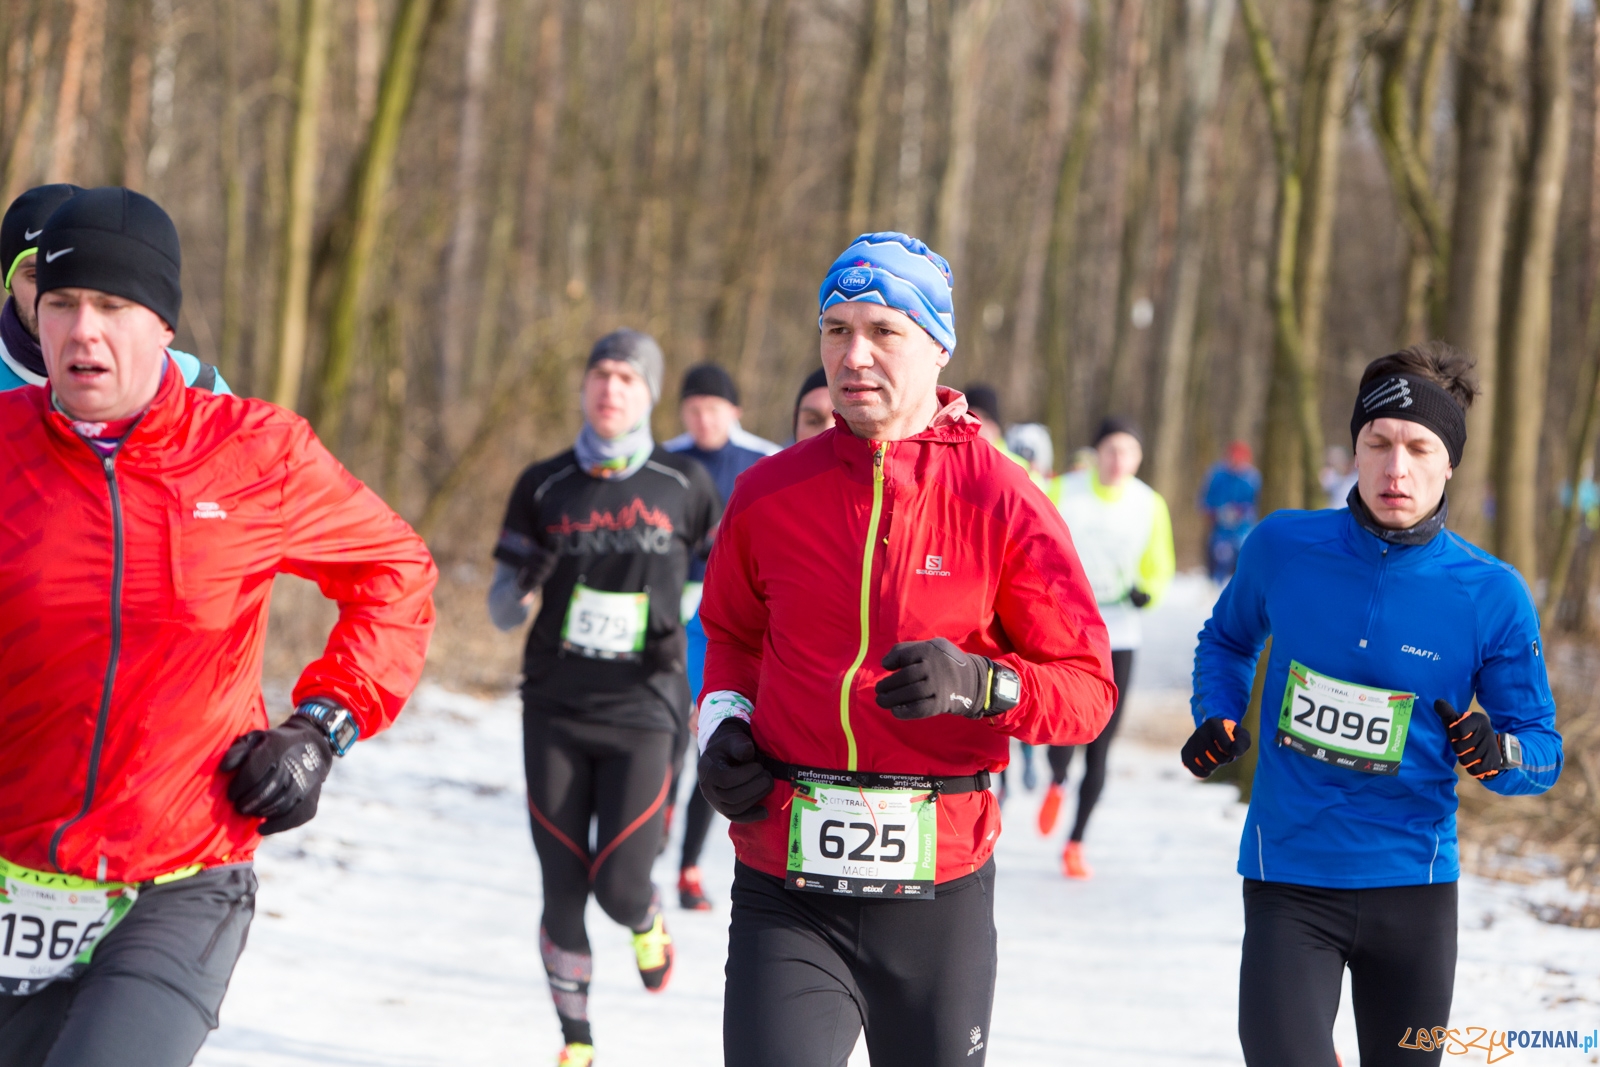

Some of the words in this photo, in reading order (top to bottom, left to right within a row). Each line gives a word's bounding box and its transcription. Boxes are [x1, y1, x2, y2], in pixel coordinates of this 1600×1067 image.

[579, 609, 628, 640] 579
[1401, 644, 1434, 659] CRAFT
[1294, 694, 1390, 745] 2096
[797, 770, 853, 782] performance
[879, 774, 925, 782] compressport
[894, 780, 932, 789] anti-shock
[819, 819, 906, 863] 625
[922, 833, 932, 869] Poznań
[842, 865, 879, 877] MACIEJ
